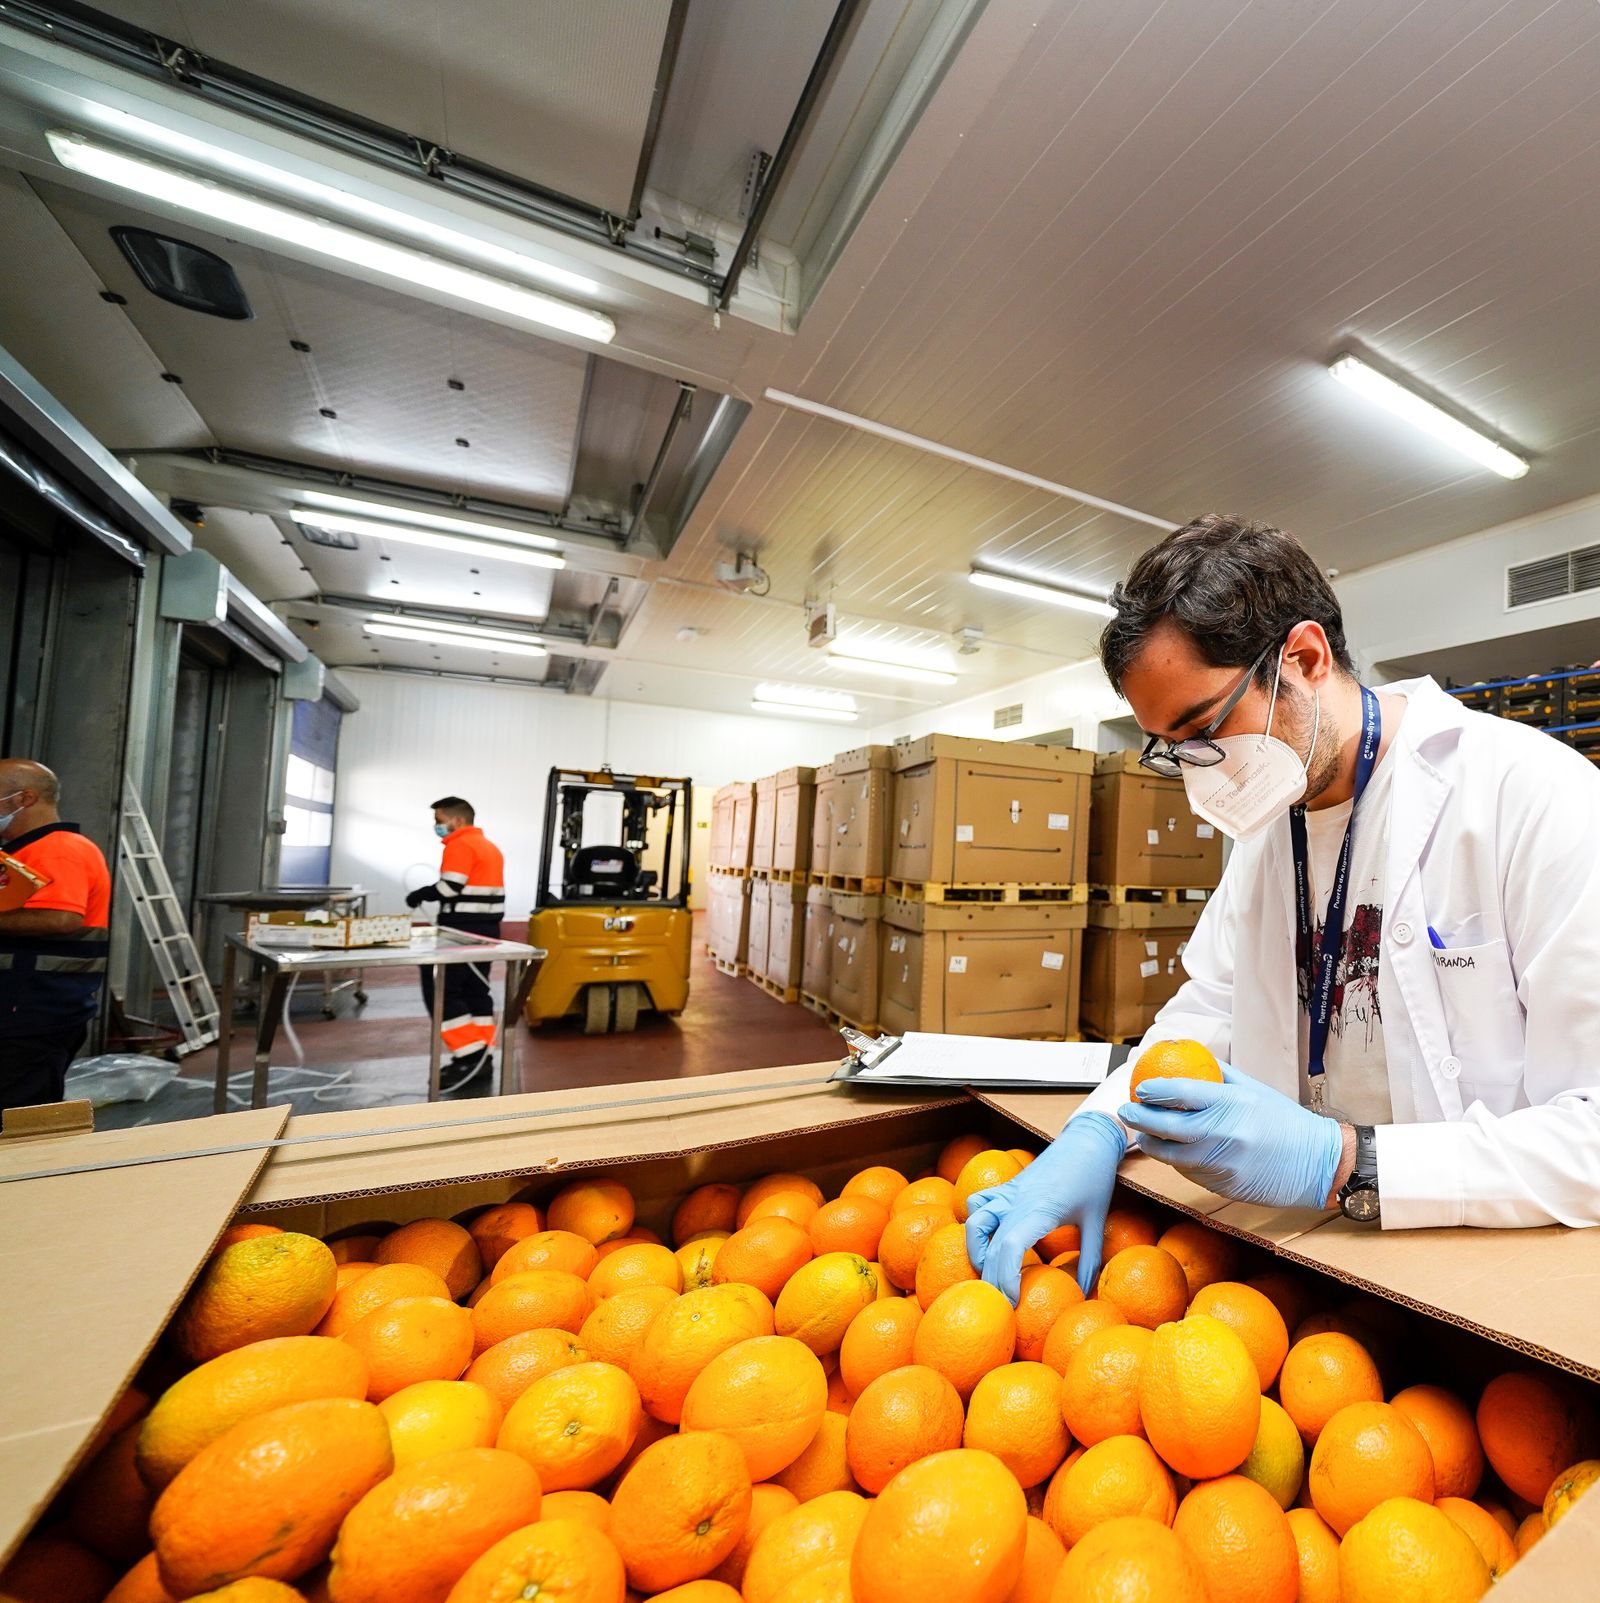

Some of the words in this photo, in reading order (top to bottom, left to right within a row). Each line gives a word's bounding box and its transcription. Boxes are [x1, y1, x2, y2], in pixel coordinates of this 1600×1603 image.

[1368, 711, 1375, 719] de
[1365, 720, 1375, 753] Algeciras
[1341, 838, 1349, 873] Algeciras
[1339, 874, 1345, 886] de
[1300, 884, 1304, 895] de
[1333, 886, 1342, 909] Puerto
[604, 917, 628, 931] CAT
[1322, 960, 1333, 991] Algeciras
[1321, 991, 1329, 1003] de
[1318, 1003, 1328, 1024] Puerto
